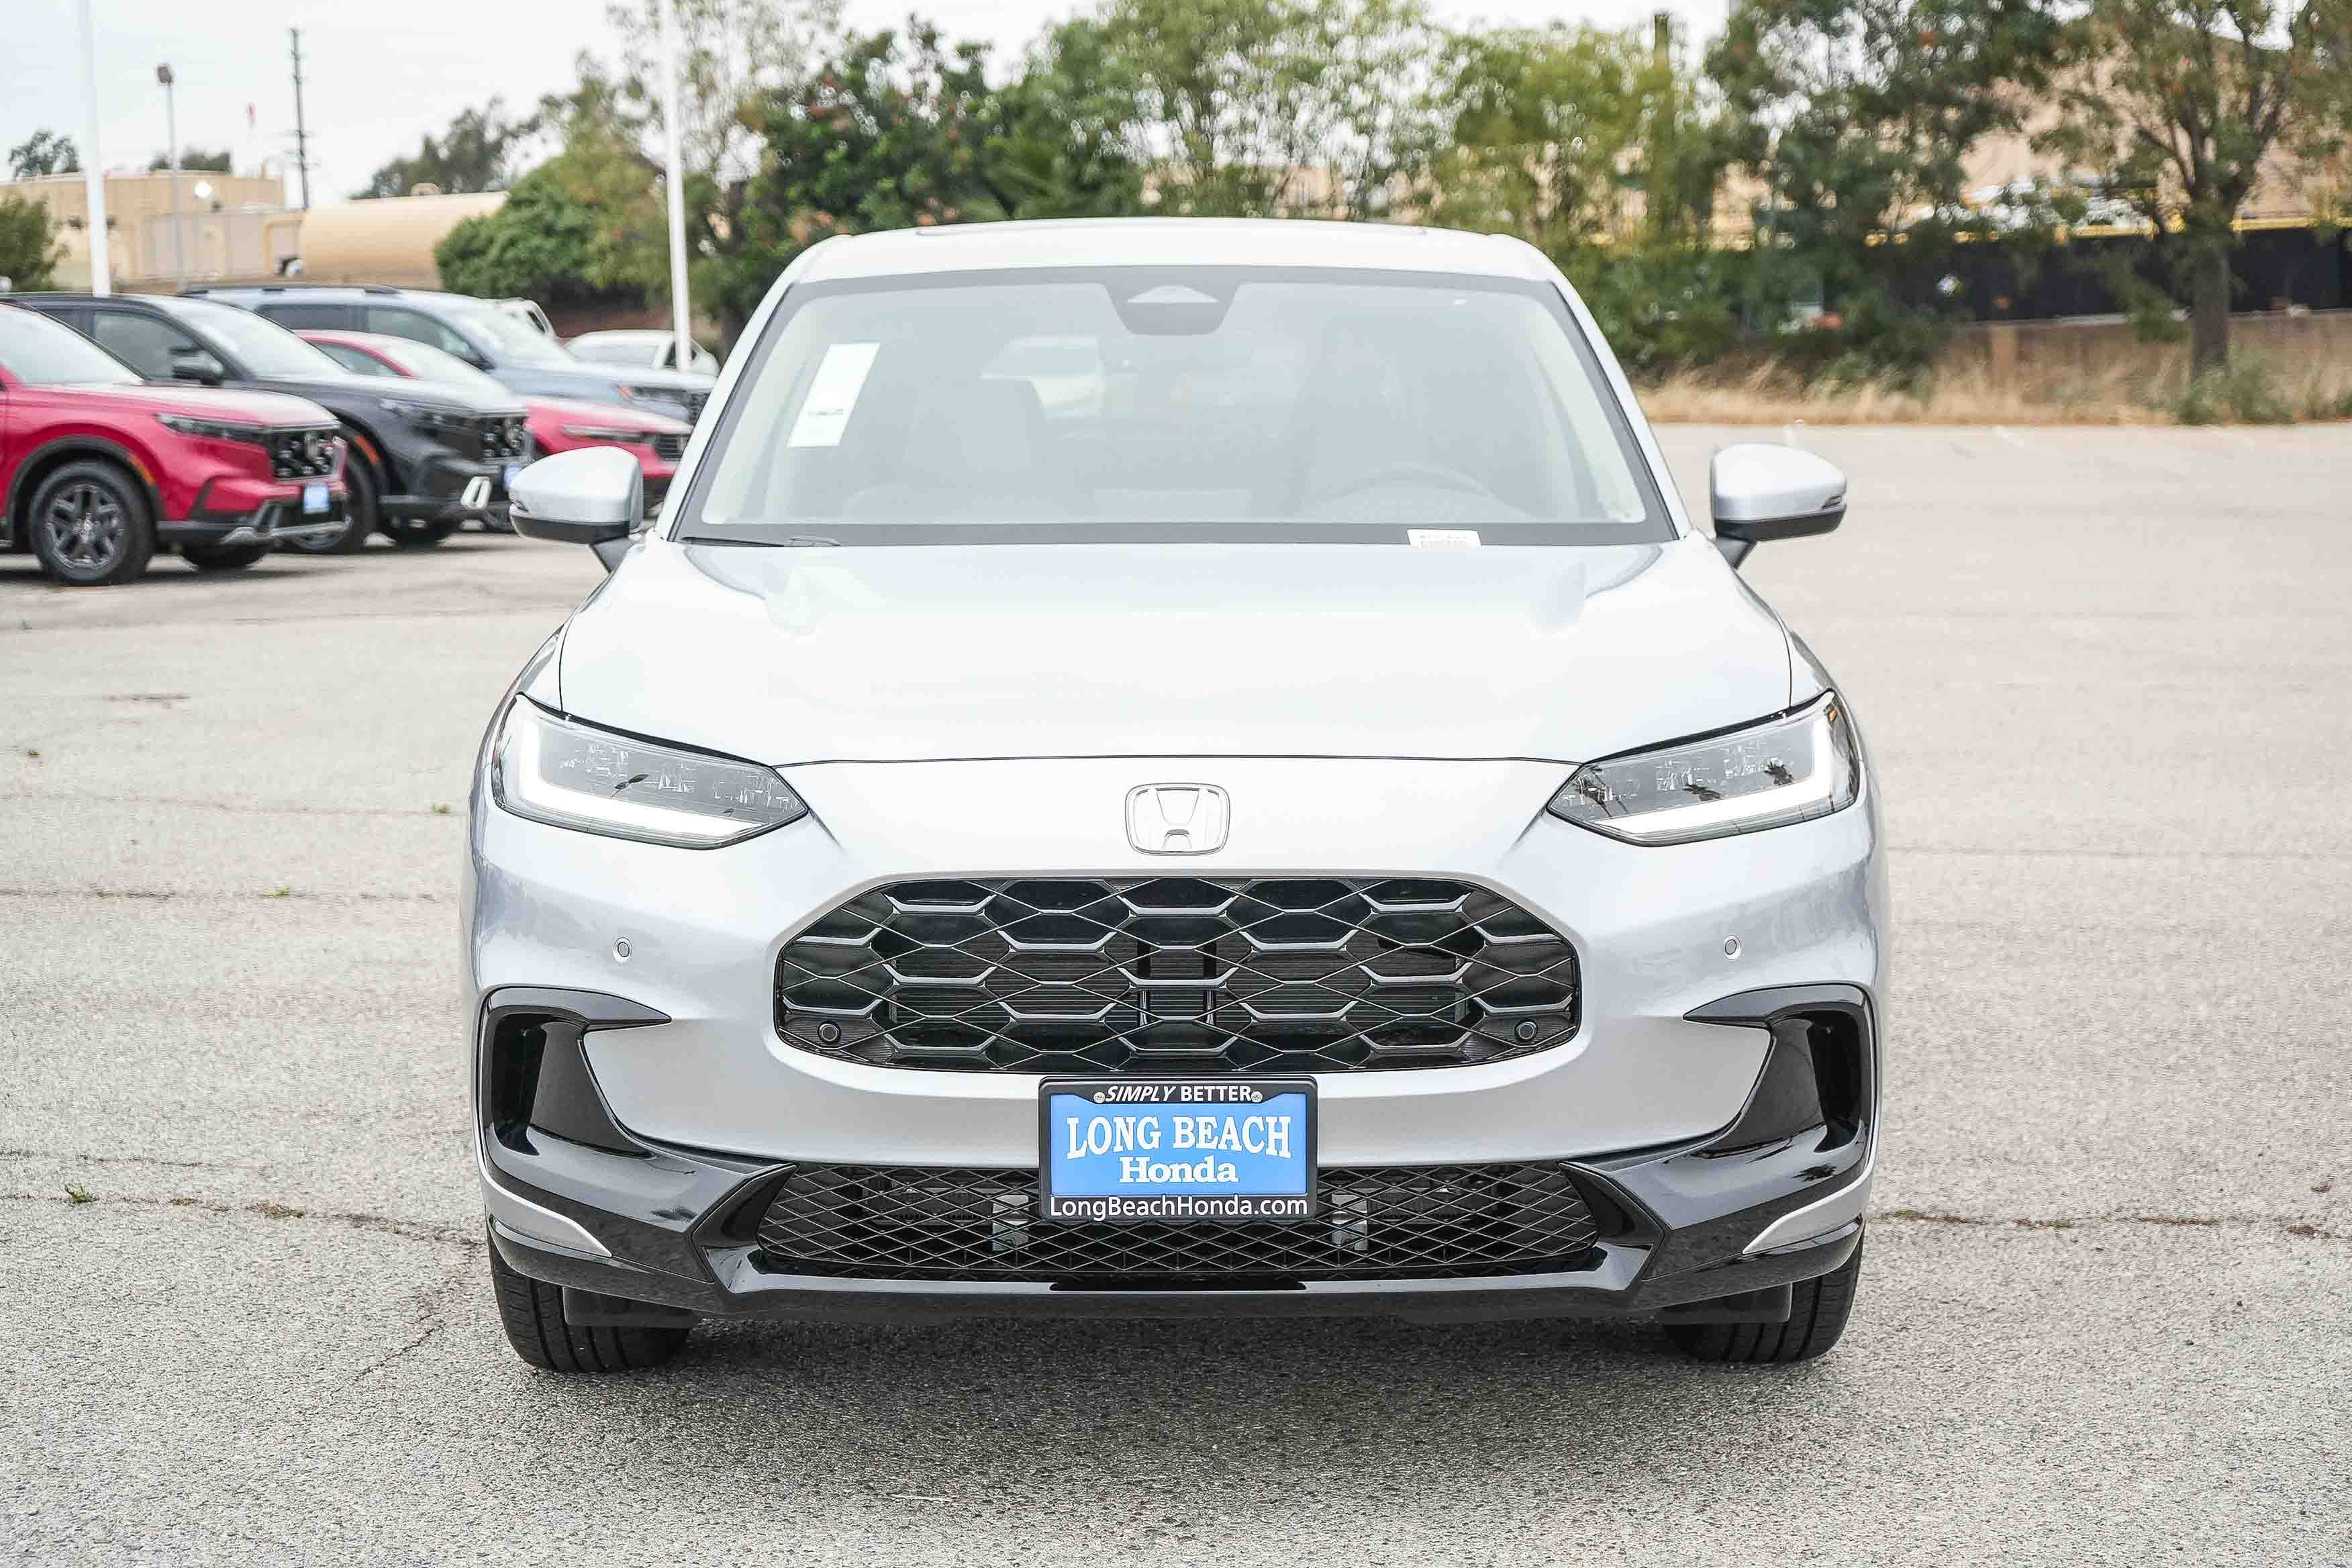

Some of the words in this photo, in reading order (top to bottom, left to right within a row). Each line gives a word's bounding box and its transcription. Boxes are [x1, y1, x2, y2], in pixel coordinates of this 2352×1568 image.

[1106, 1085, 1176, 1102] SIMPLY
[1181, 1085, 1252, 1102] BETTER
[1067, 1116, 1162, 1160] LONG
[1173, 1116, 1292, 1159] BEACH
[1118, 1155, 1240, 1183] Honda
[1050, 1194, 1308, 1222] LongBeachHonda.com
